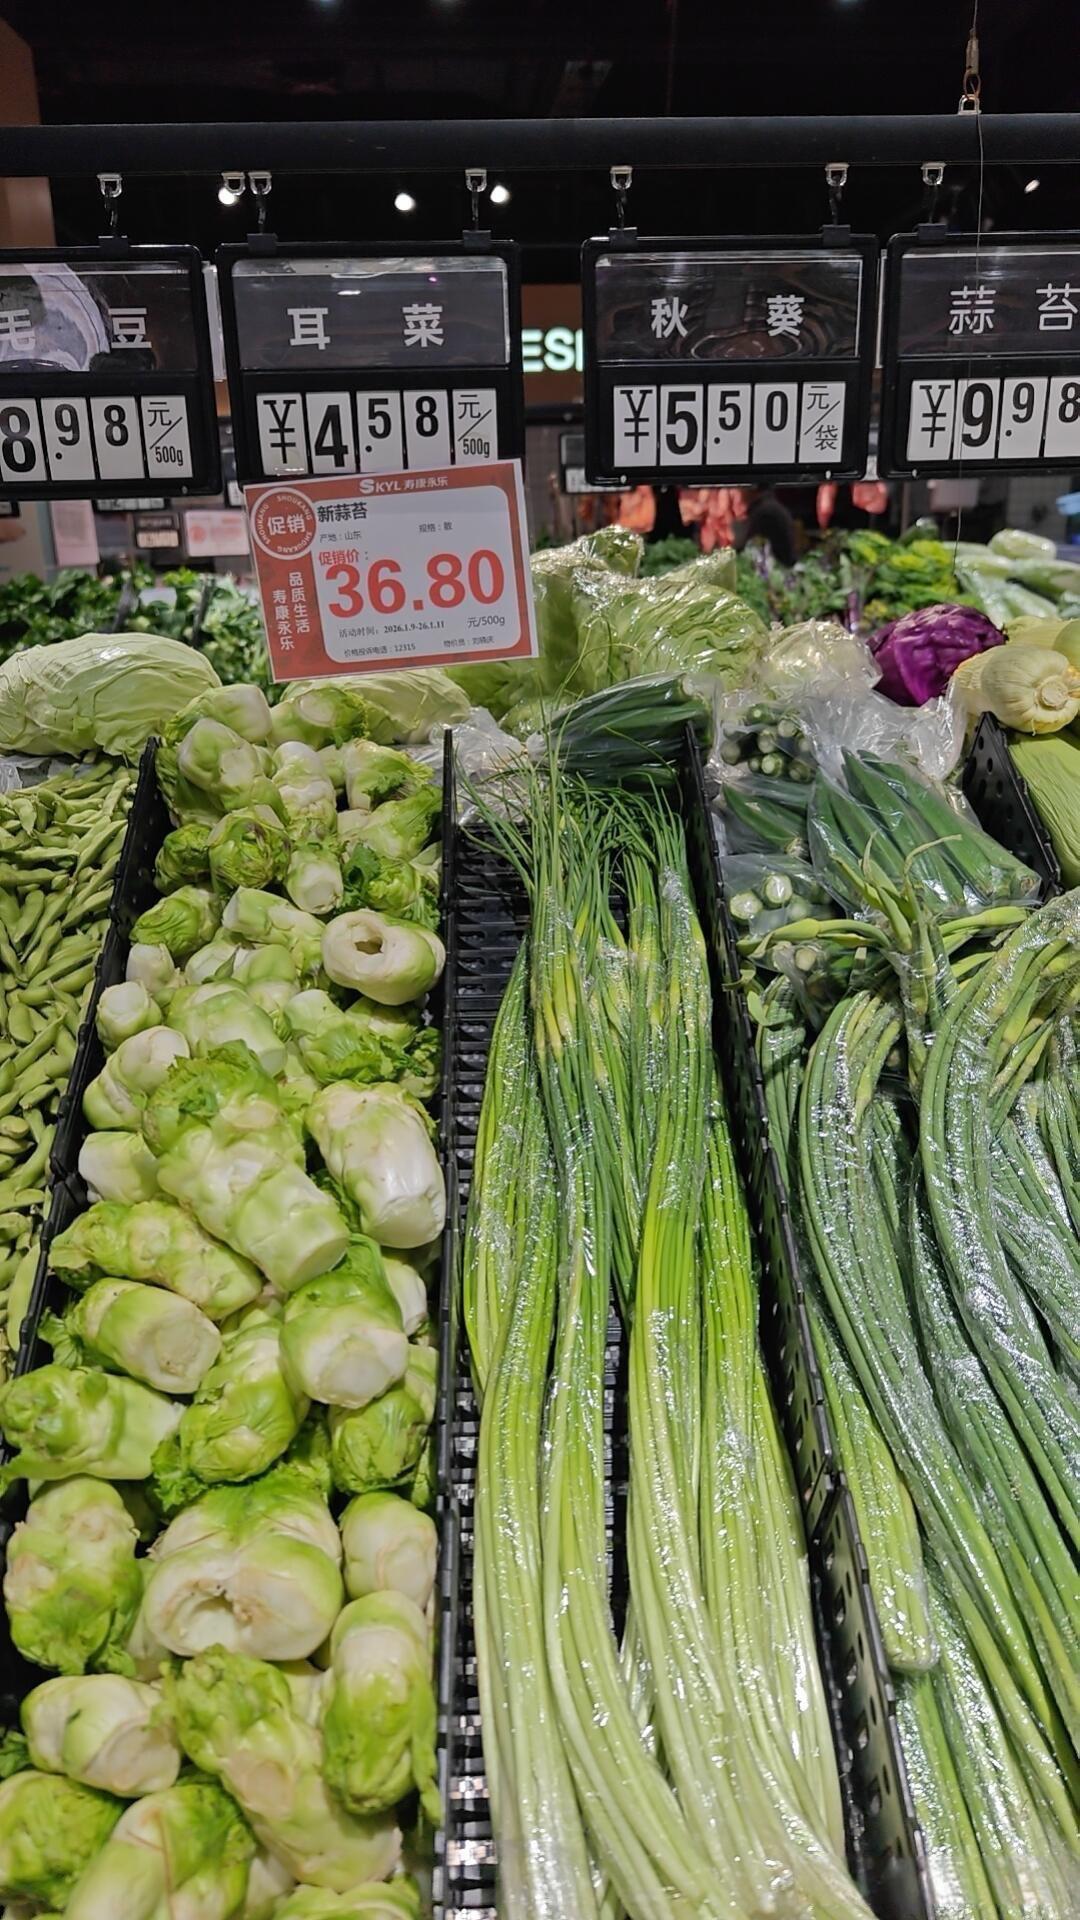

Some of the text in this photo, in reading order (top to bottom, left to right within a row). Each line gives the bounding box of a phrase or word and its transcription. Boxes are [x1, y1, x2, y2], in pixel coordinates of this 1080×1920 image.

[359, 476, 449, 495] SKYL 寿康永乐
[316, 501, 368, 523] 新蒜苔
[267, 513, 307, 536] 促销
[324, 548, 506, 620] 36.80
[288, 571, 311, 634] 品质生活
[272, 589, 296, 651] 寿康永乐
[466, 615, 506, 629] 元/500g
